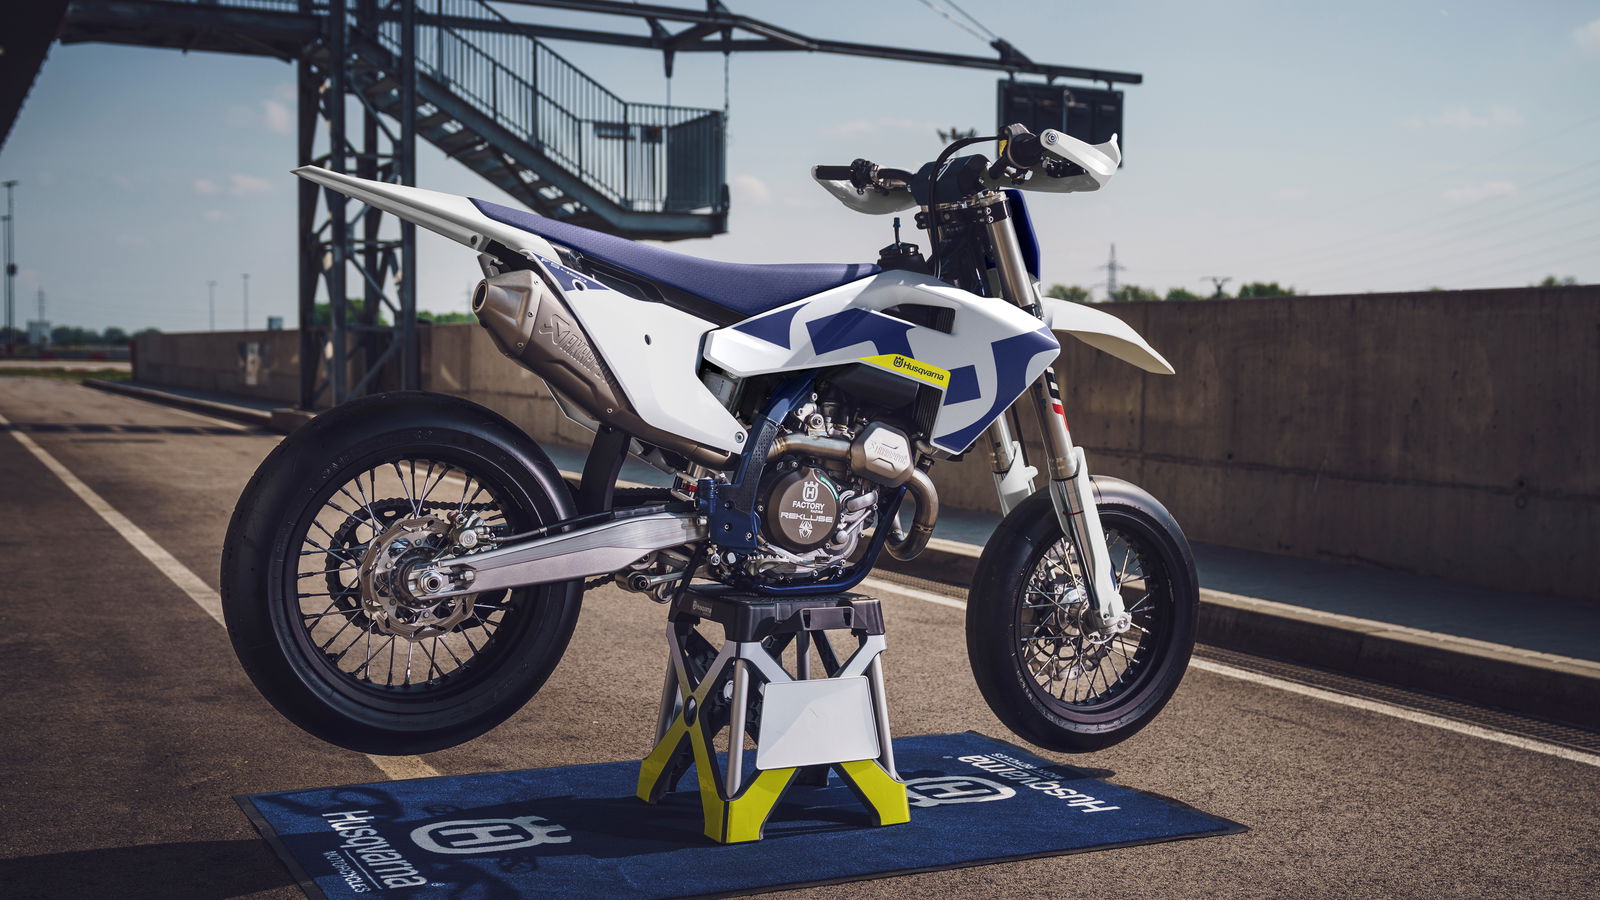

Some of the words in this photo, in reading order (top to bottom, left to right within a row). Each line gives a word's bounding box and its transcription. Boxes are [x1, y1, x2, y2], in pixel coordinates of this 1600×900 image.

[903, 361, 945, 381] Husqvarna
[792, 500, 825, 511] FACTORY
[780, 511, 833, 523] REKLUSE
[957, 754, 1121, 813] Husqvarna
[322, 810, 427, 889] Husqvarna
